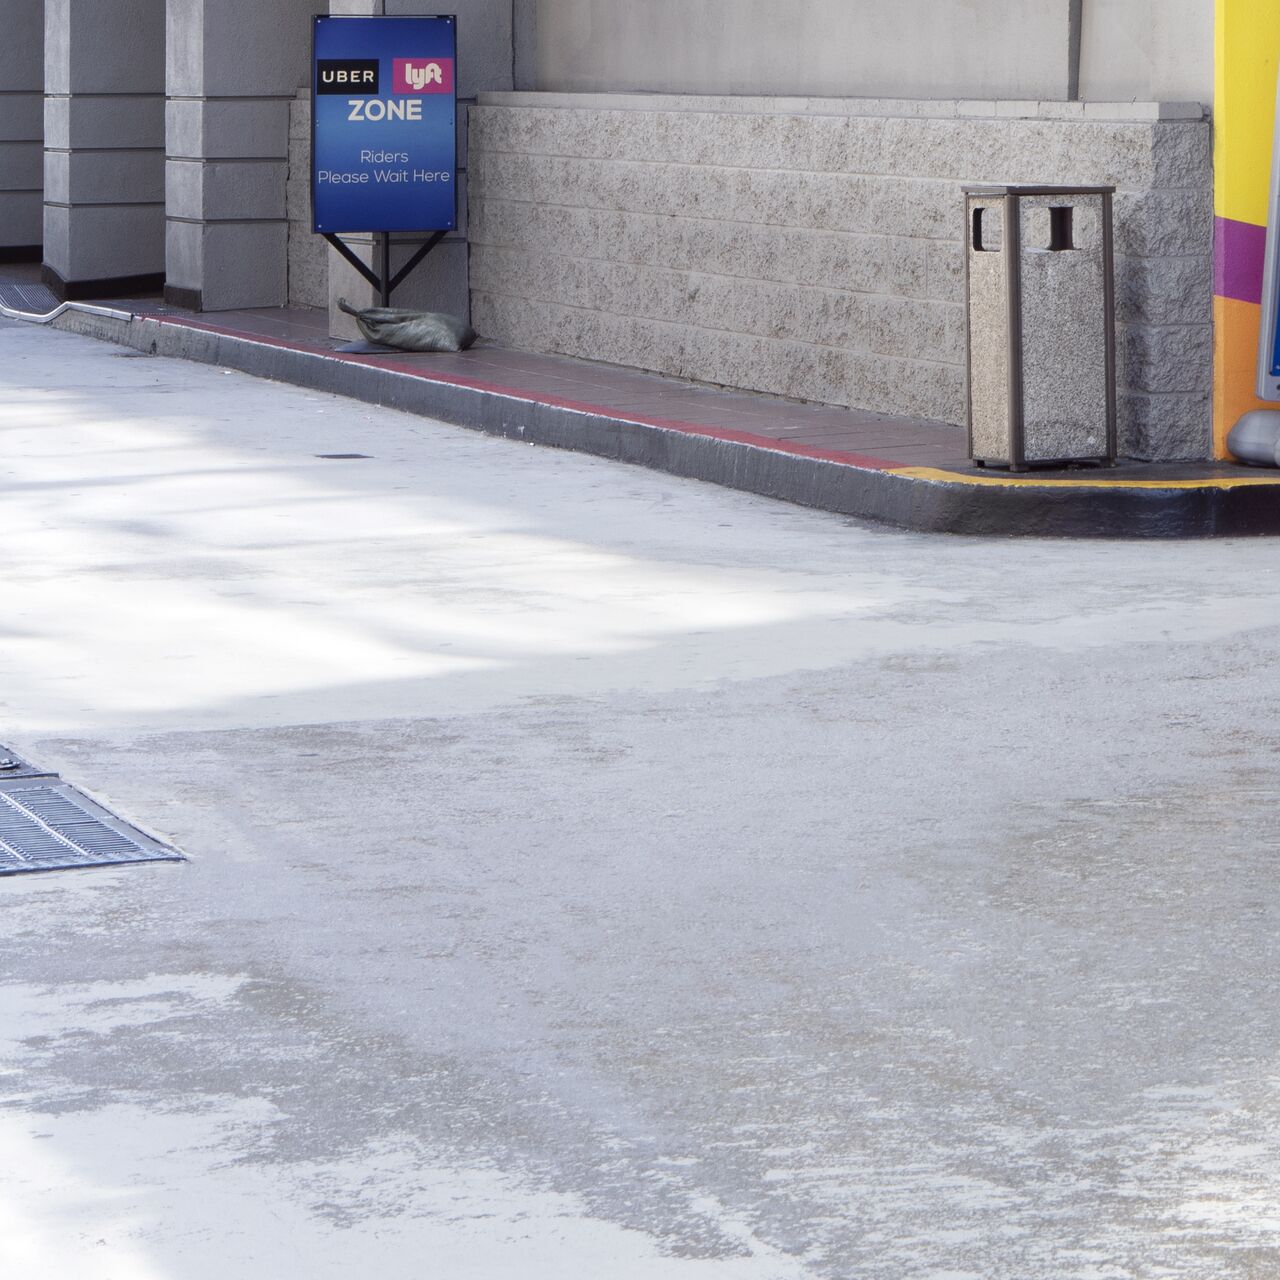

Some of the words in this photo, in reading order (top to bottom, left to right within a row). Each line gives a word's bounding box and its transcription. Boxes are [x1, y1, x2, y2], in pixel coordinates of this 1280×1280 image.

[322, 70, 374, 83] UBER
[405, 63, 442, 90] lyft
[348, 99, 422, 121] ZONE
[360, 150, 408, 163] Riders
[318, 170, 369, 183] Please
[374, 169, 408, 182] Wait
[413, 169, 450, 182] Here
